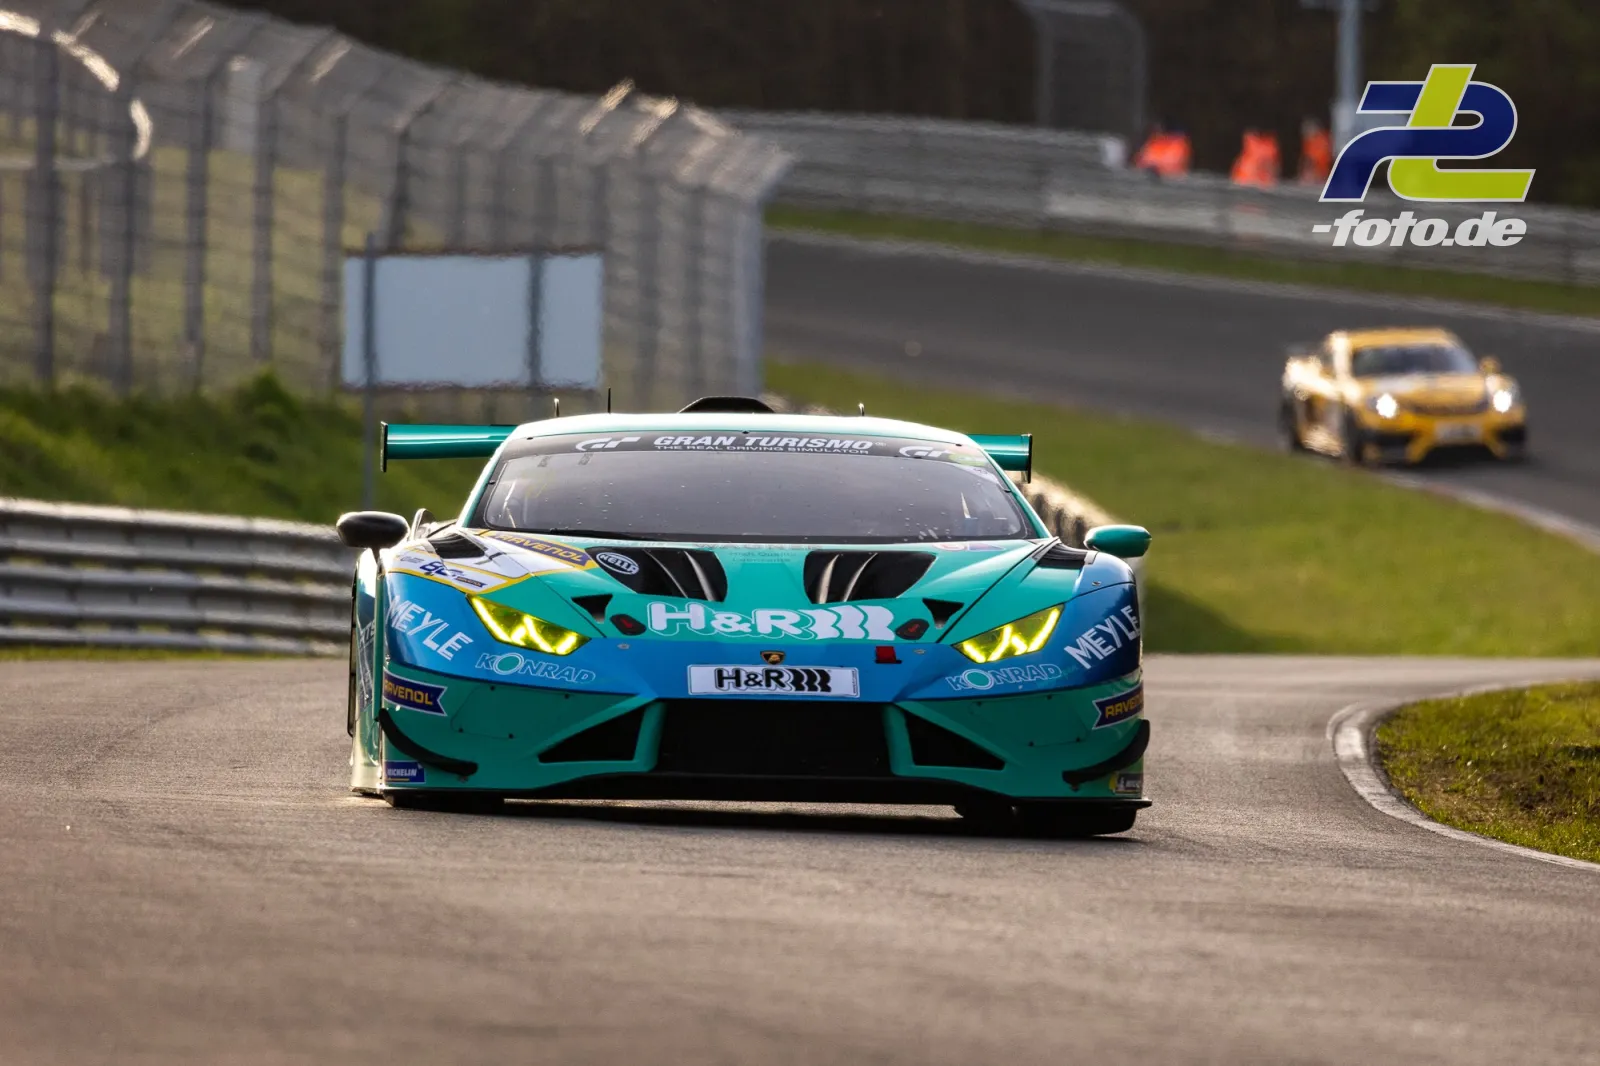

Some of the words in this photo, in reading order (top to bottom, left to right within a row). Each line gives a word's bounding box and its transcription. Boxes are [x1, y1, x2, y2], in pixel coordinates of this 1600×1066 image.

[653, 435, 736, 447] GRAN
[744, 436, 874, 450] TURISMO
[787, 447, 869, 455] SIMULATOR
[496, 533, 584, 562] RAVENOL
[599, 553, 640, 575] HELLA
[388, 594, 475, 661] MEYLE
[1063, 604, 1141, 670] MEYLE
[475, 651, 596, 684] KONRAD
[714, 667, 792, 692] H&R
[945, 663, 1063, 691] KONRAD
